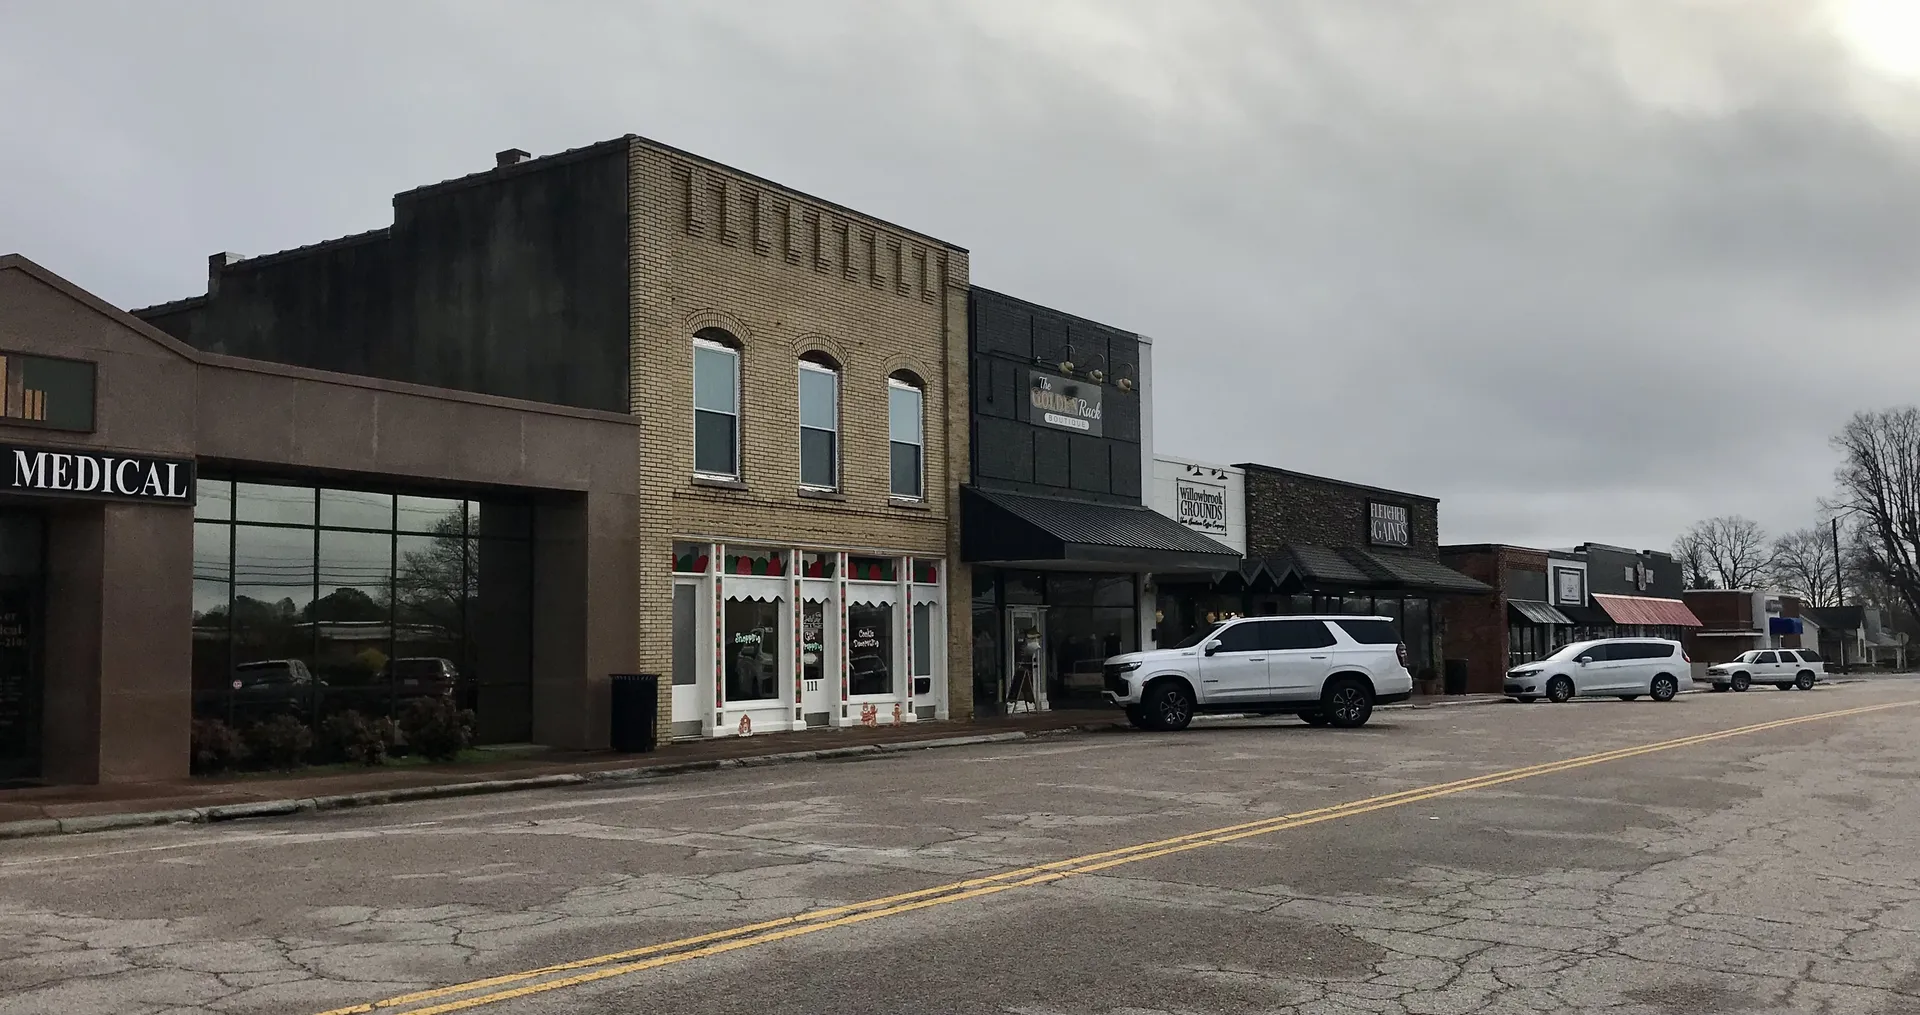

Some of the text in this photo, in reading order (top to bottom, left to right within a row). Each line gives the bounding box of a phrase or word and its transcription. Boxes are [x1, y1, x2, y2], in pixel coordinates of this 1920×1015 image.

[1038, 376, 1052, 391] The
[1078, 398, 1102, 420] Rack
[1048, 414, 1086, 428] BOUTIQUE
[12, 450, 188, 498] MEDICAL
[1180, 487, 1223, 505] Willowbrook
[1180, 500, 1223, 520] GROUNDS
[1371, 502, 1408, 525] FLETCHER
[735, 632, 761, 644] Shopping
[806, 681, 818, 692] 111
